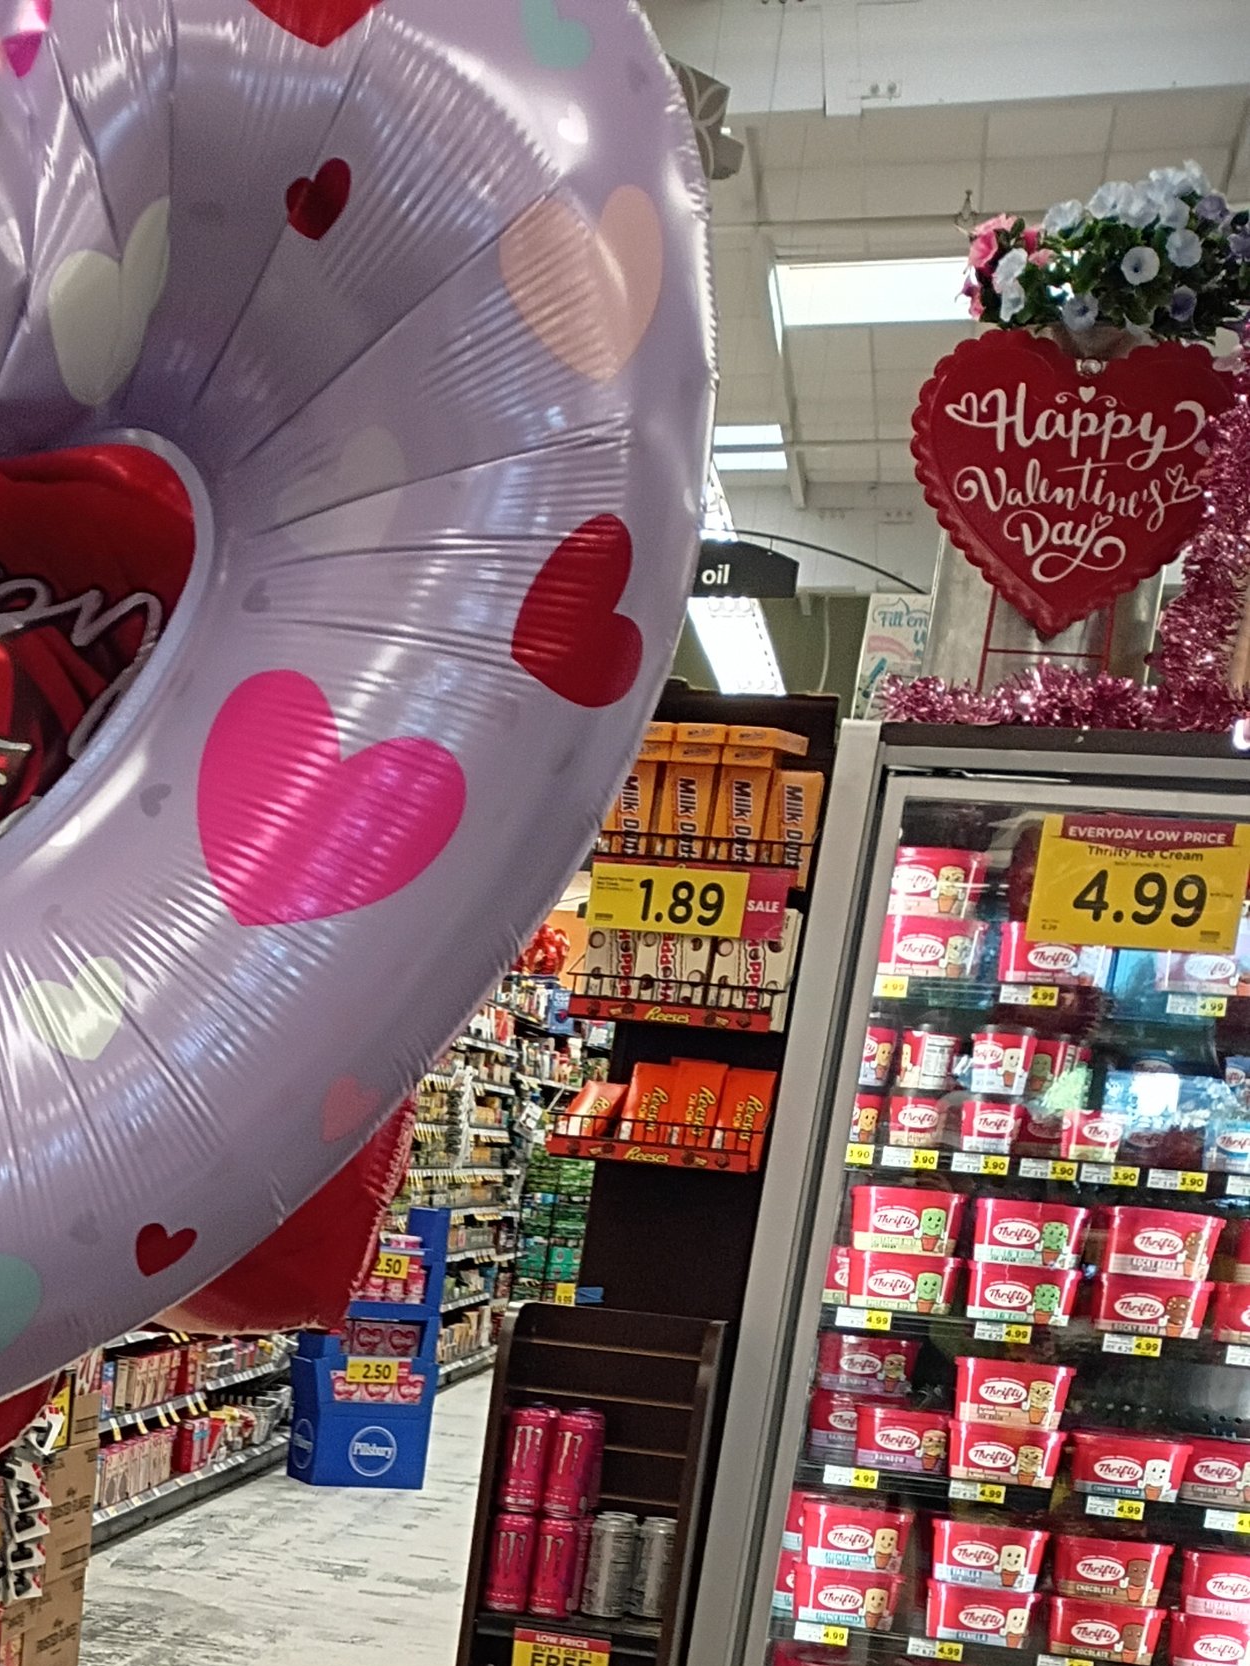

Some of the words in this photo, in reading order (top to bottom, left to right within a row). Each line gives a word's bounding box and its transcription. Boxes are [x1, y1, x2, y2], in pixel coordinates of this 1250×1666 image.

[945, 382, 1206, 471] Happy
[954, 457, 1175, 532] Valentine's
[1004, 510, 1126, 583] Day
[701, 564, 731, 585] oil
[1068, 825, 1144, 840] EVERYDAY
[1146, 828, 1182, 842] LOW
[1183, 831, 1227, 844] PRICE
[1087, 844, 1133, 860] Thrifty
[1159, 849, 1204, 862] Cream
[638, 877, 726, 927] 1.89
[1072, 868, 1208, 928] 4.99
[746, 899, 780, 913] SALE
[1033, 950, 1074, 968] Thrifty
[1031, 991, 1054, 1000] 4.99
[1199, 1002, 1224, 1011] 4.99
[644, 1005, 690, 1025] Reese's
[623, 1146, 671, 1165] Reese's
[913, 1155, 935, 1164] 3.90
[982, 1160, 1006, 1170] 3.90
[1050, 1166, 1074, 1176] 3.90
[1112, 1172, 1136, 1182] 3.90
[1180, 1177, 1204, 1188] 3.90
[877, 1213, 916, 1228] Thrifty
[998, 1225, 1037, 1242] Thrifty
[1138, 1235, 1179, 1251] Thrifty
[872, 1276, 911, 1291] Thrifty
[988, 1288, 1028, 1303] Thrifty
[1119, 1300, 1160, 1316] Thrifty
[866, 1316, 889, 1325] 4.99
[1005, 1328, 1028, 1338] 4.99
[1134, 1342, 1159, 1352] 4.99
[362, 1364, 391, 1380] 2.50
[984, 1386, 1023, 1401] Thrifty
[879, 1432, 917, 1447] Thrifty
[353, 1440, 395, 1459] Pillsbury
[973, 1449, 1013, 1464] Thrifty
[854, 1475, 876, 1484] 4.99
[1099, 1464, 1140, 1480] Thrifty
[1199, 1464, 1238, 1480] Thrifty
[979, 1488, 1002, 1498] 4.99
[1117, 1503, 1141, 1514] 4.99
[832, 1531, 871, 1546] Thrifty
[958, 1547, 998, 1563] Thrifty
[1081, 1562, 1122, 1579] Thrifty
[1076, 1584, 1115, 1595] CHOCOLATE
[823, 1591, 861, 1606] Thrifty
[964, 1610, 1002, 1626] Thrifty
[535, 1634, 558, 1644] LOW
[559, 1637, 589, 1649] PRICE
[823, 1631, 845, 1641] 4.99
[1075, 1627, 1116, 1643] Thrifty
[563, 1648, 586, 1657] GET
[938, 1645, 960, 1657] 4.99
[1071, 1648, 1109, 1659] CHOCOLATE
[1200, 1641, 1243, 1659] Thrifty
